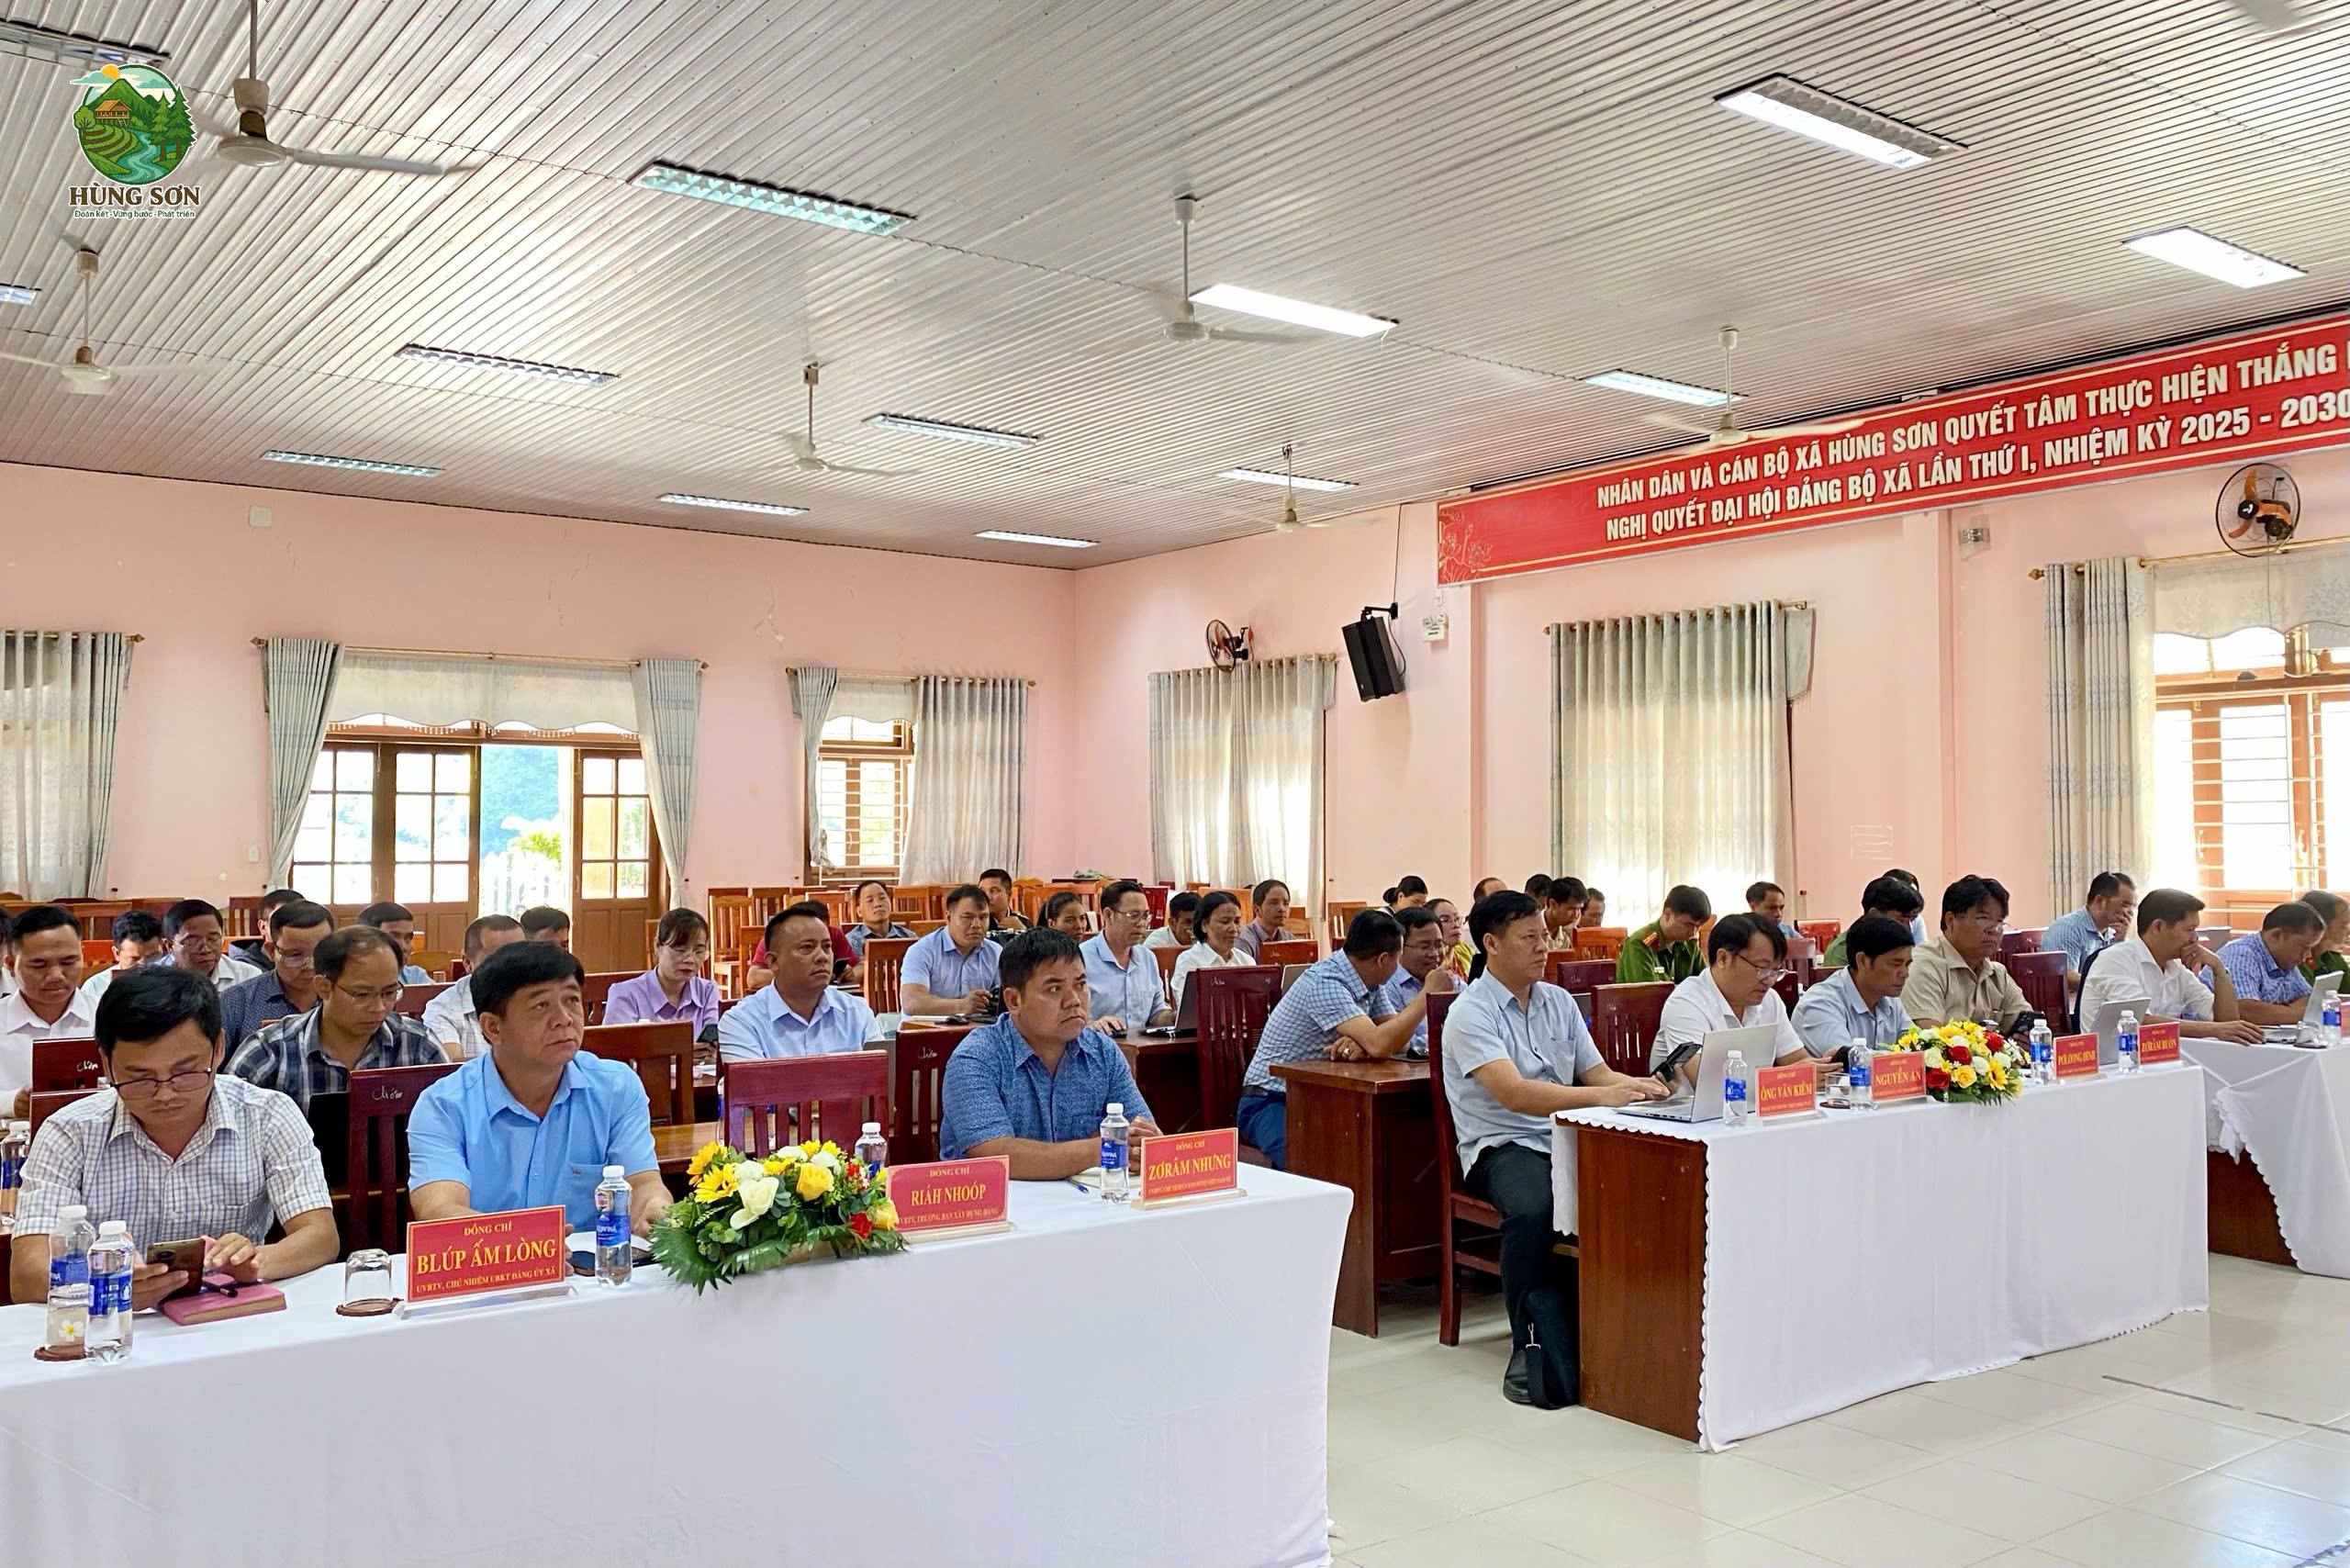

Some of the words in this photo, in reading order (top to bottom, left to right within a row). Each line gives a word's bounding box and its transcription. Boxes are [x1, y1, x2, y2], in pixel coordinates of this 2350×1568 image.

[1597, 477, 1644, 509] NHÂN
[1649, 470, 1685, 498] DÂN
[1690, 462, 1714, 491] VÀ
[1718, 454, 1751, 487] CÁN
[1762, 445, 1789, 480] BỘ
[1796, 439, 1823, 471] XÃ
[1829, 431, 1886, 465] HÙNG
[1892, 420, 1938, 454] SƠN
[1944, 398, 2018, 445] QUYẾT
[2023, 394, 2077, 429] TÂM
[2085, 378, 2153, 417] THỰC
[2162, 364, 2228, 404] HIỆN
[2236, 341, 2337, 389] THẮNG
[1606, 512, 1648, 542] NGHỊ
[1651, 497, 1707, 534] QUYẾT
[1710, 496, 1743, 526] ĐẠI
[1748, 486, 1781, 521] HỘI
[1785, 476, 1842, 519] ĐẢNG
[1848, 467, 1877, 502] BỘ
[1883, 461, 1913, 496] XÃ
[1918, 451, 1963, 488] LẦN
[1968, 443, 2017, 480] THỨ
[2020, 445, 2037, 474] I,
[2044, 427, 2130, 465] NHIỆM
[2136, 415, 2173, 454] KỲ
[2180, 407, 2250, 445] 2025
[2259, 414, 2272, 423] -
[2280, 388, 2350, 429] 2030
[1148, 1156, 1191, 1181] ZƠRÂM
[1192, 1153, 1232, 1174] NHƯNG
[911, 1183, 942, 1206] RIÁH
[944, 1180, 987, 1204] NHOÓP
[464, 1223, 492, 1237] ĐỒNG
[494, 1220, 512, 1232] CHÍ
[416, 1245, 467, 1274] BLÚP
[470, 1238, 500, 1269] ẤM
[505, 1237, 557, 1263] LÒNG
